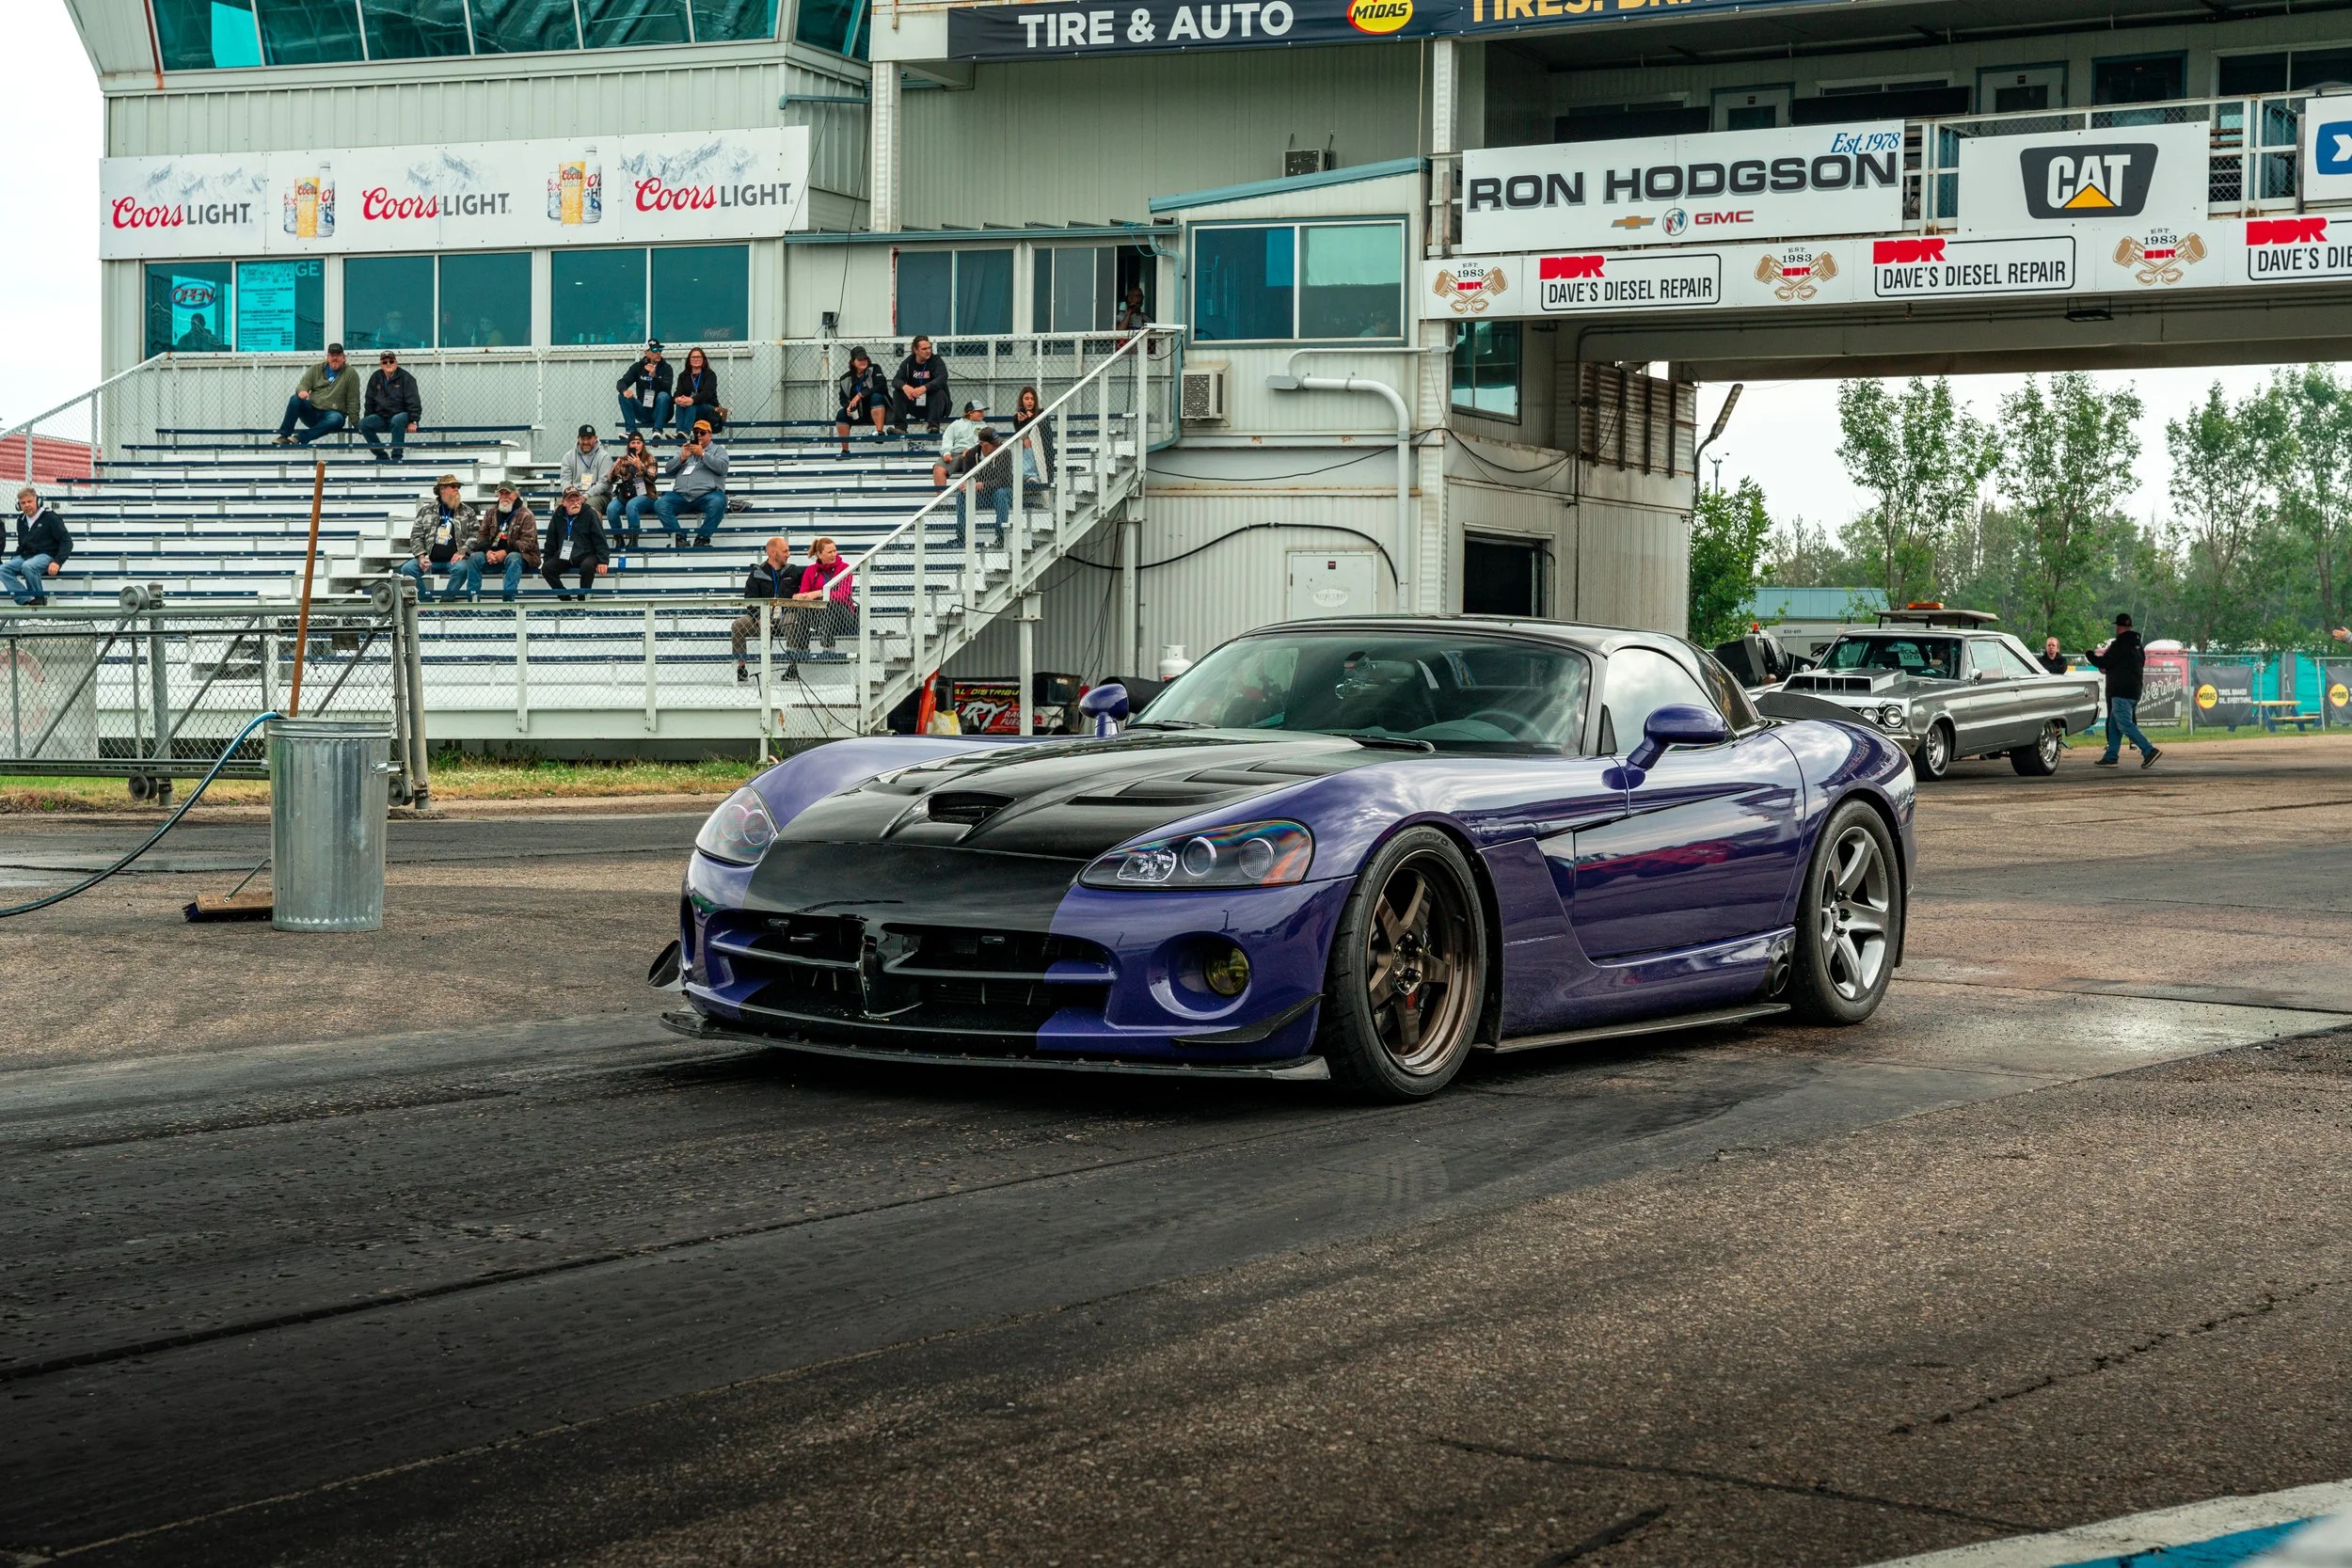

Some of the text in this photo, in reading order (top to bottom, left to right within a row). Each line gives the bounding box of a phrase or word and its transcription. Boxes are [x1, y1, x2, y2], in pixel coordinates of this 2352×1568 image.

[1018, 0, 1295, 48] TIRE & AUTO
[1351, 2, 1408, 22] MIDAS
[1864, 132, 1901, 152] 1978
[1468, 151, 1899, 213] RON HODGSON
[2046, 153, 2132, 209] CAT
[362, 187, 510, 220] Coors LIGHT
[634, 177, 792, 213] Coors LIGHT
[112, 196, 251, 230] Coors LIGHT
[1693, 210, 1755, 226] GMC
[2144, 234, 2178, 245] 1983
[2246, 217, 2328, 245] DDR
[1782, 253, 1813, 263] 1983
[1872, 237, 1947, 264] DDR
[2258, 246, 2320, 272] DAVE'S
[1456, 269, 1485, 278] 1983
[1539, 255, 1607, 280] DDR
[1882, 261, 2067, 290] DAVE'S DIESEL REPAIR
[171, 288, 215, 303] OPEN
[1549, 277, 1713, 304] DAVE'S DIESEL REPAIR
[2199, 692, 2217, 701] MIDAS
[1415, 831, 1450, 847] TOYO
